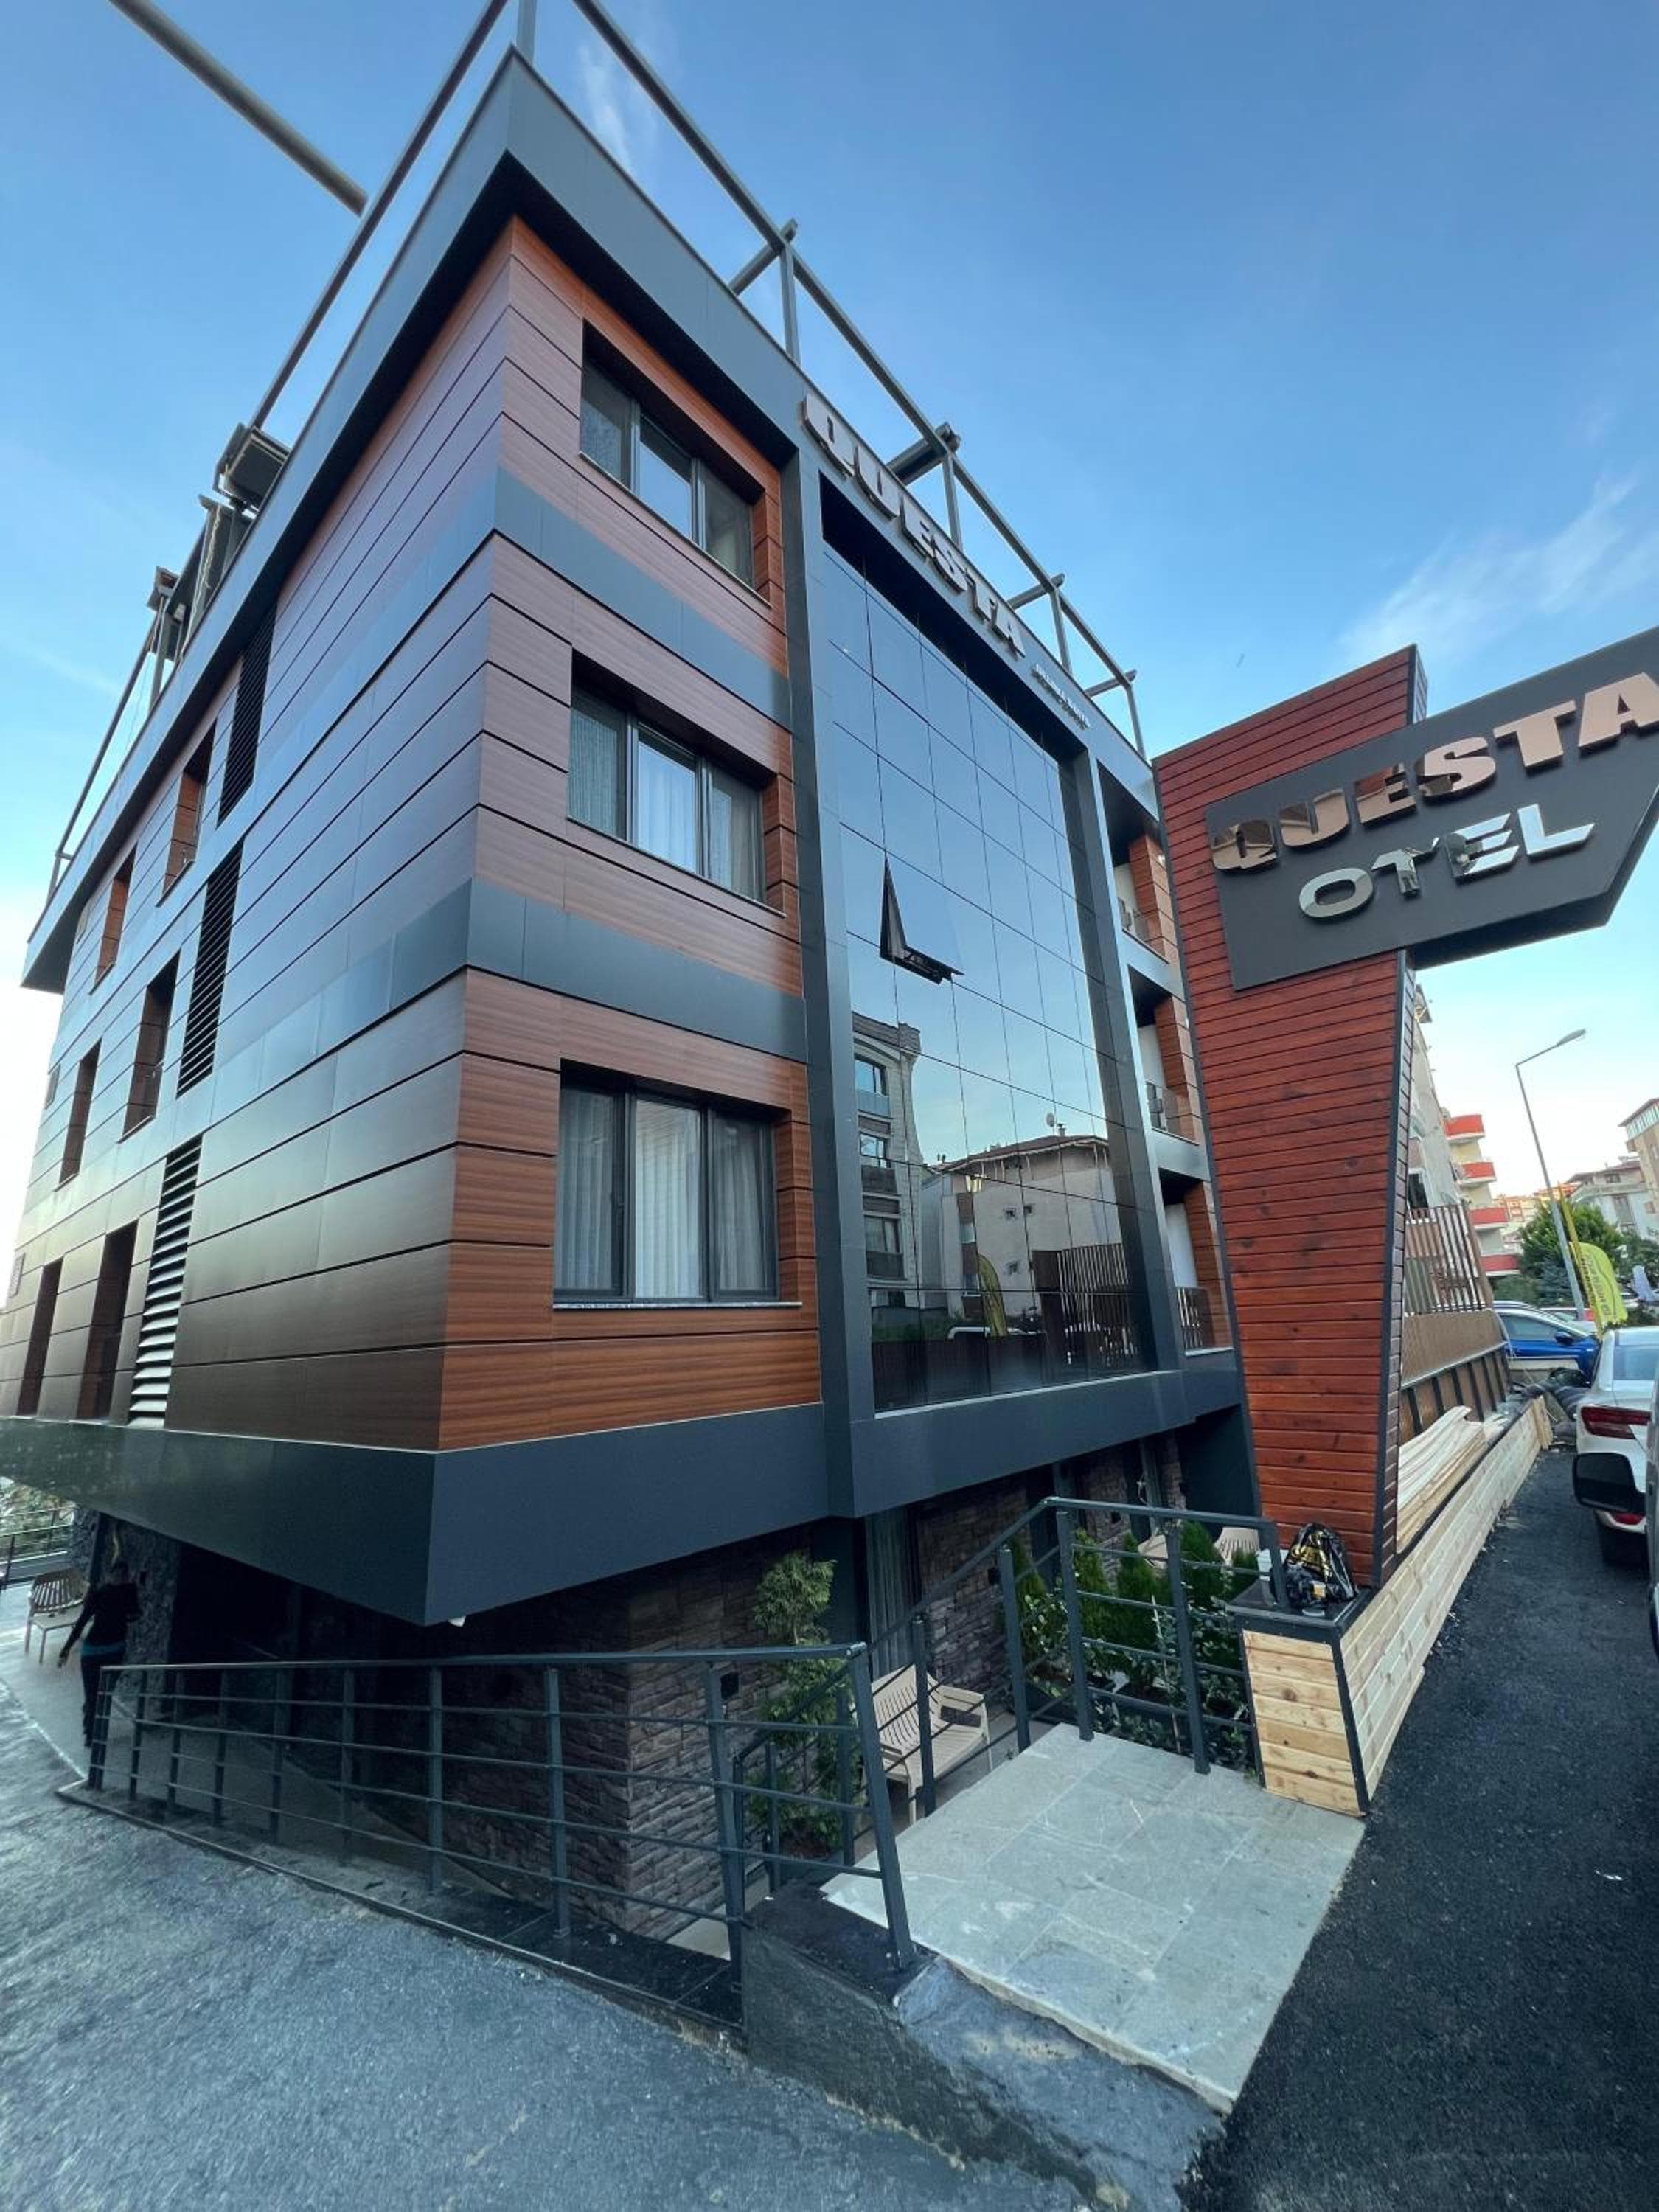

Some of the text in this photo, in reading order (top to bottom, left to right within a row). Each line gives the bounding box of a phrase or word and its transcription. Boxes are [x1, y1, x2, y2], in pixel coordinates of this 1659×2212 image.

[801, 393, 1026, 659] QUESTA
[1210, 672, 1659, 872] QUESTA
[1298, 803, 1595, 919] OTEL
